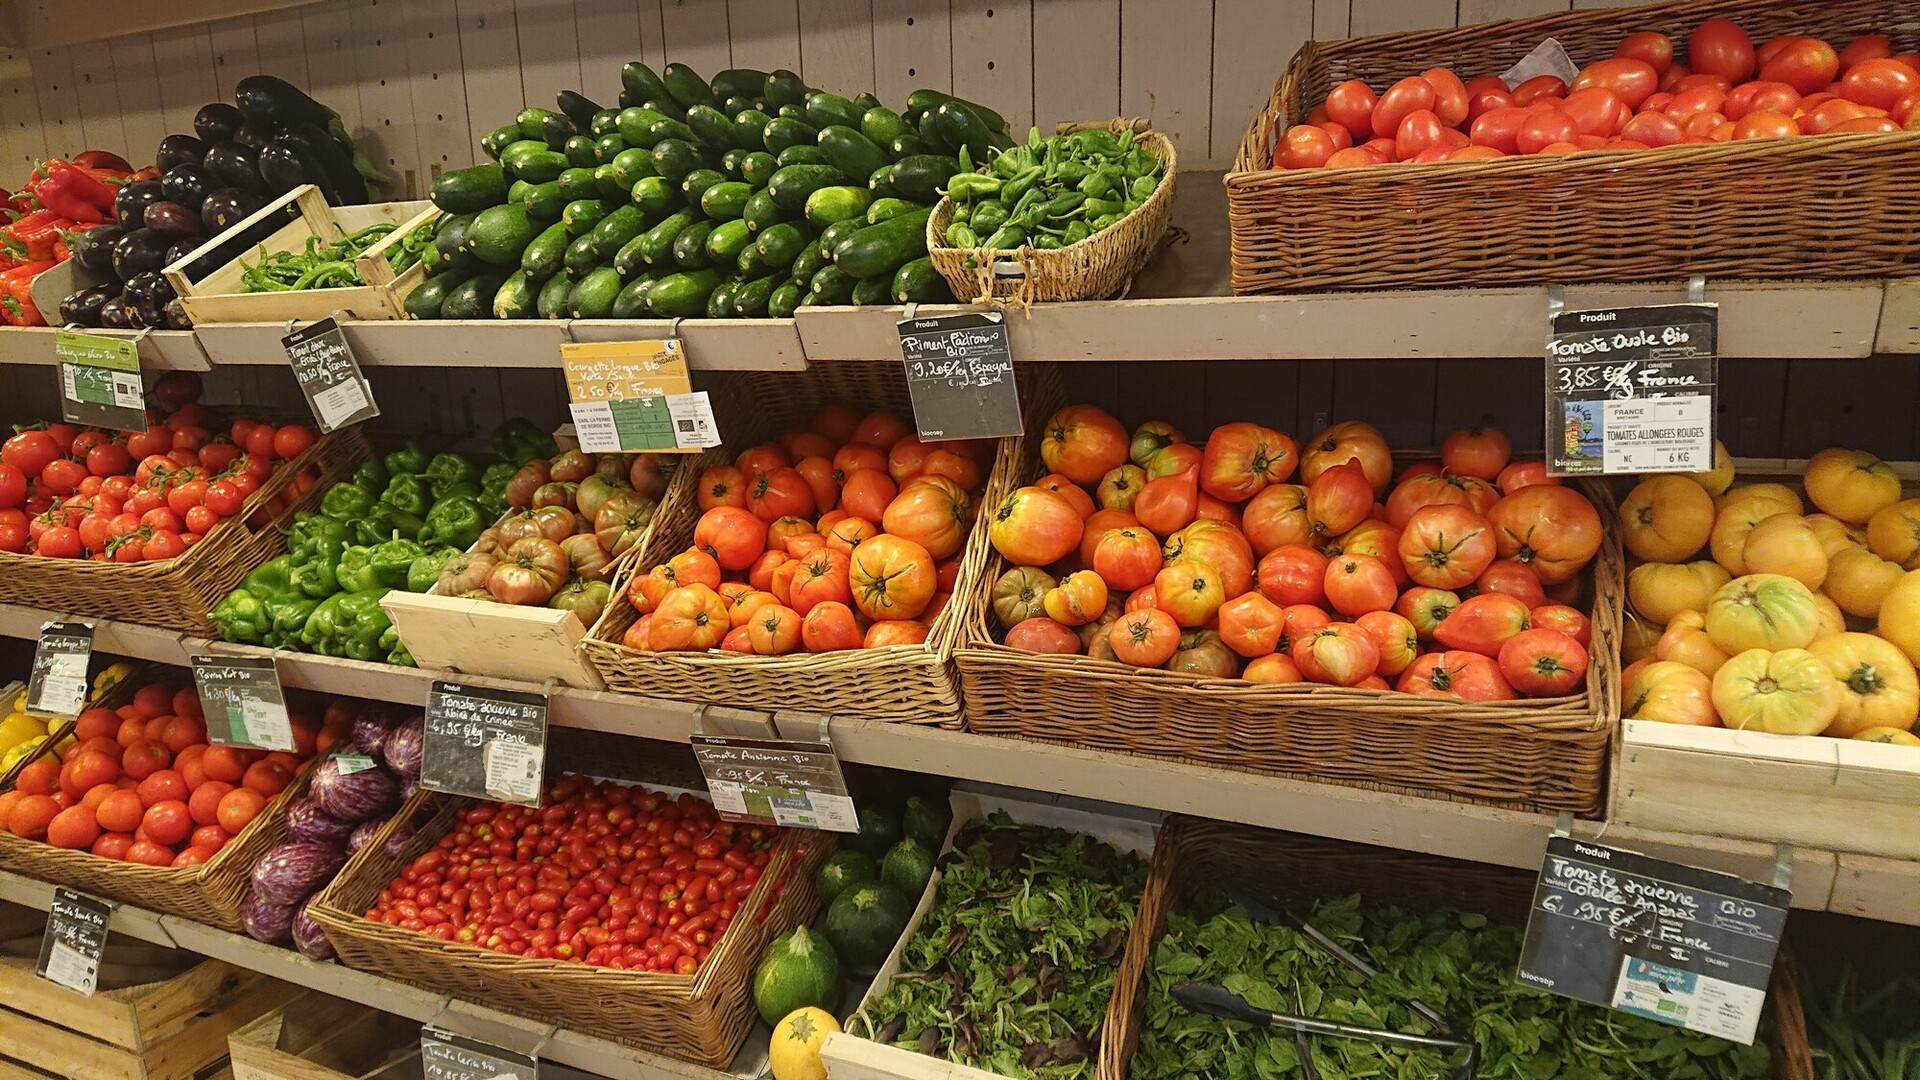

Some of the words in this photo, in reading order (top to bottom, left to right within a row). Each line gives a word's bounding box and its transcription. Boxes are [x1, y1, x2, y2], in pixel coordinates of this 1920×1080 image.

[915, 320, 939, 329] Produit
[1580, 312, 1617, 323] Produit
[901, 336, 949, 352] Piment
[1546, 337, 1611, 355] Tomate
[1661, 326, 1690, 345] Bio
[1637, 369, 1700, 387] France
[1614, 408, 1644, 416] FRANCE
[1607, 429, 1637, 441] TOMATES
[1638, 428, 1675, 440] ALLONGEES
[1677, 427, 1704, 438] ROUGES
[1624, 455, 1632, 463] NC
[1669, 453, 1675, 463] 6
[1677, 452, 1690, 462] KG
[1574, 843, 1611, 861] Produit
[1720, 900, 1757, 919] Bio
[1520, 970, 1555, 988] biocoop
